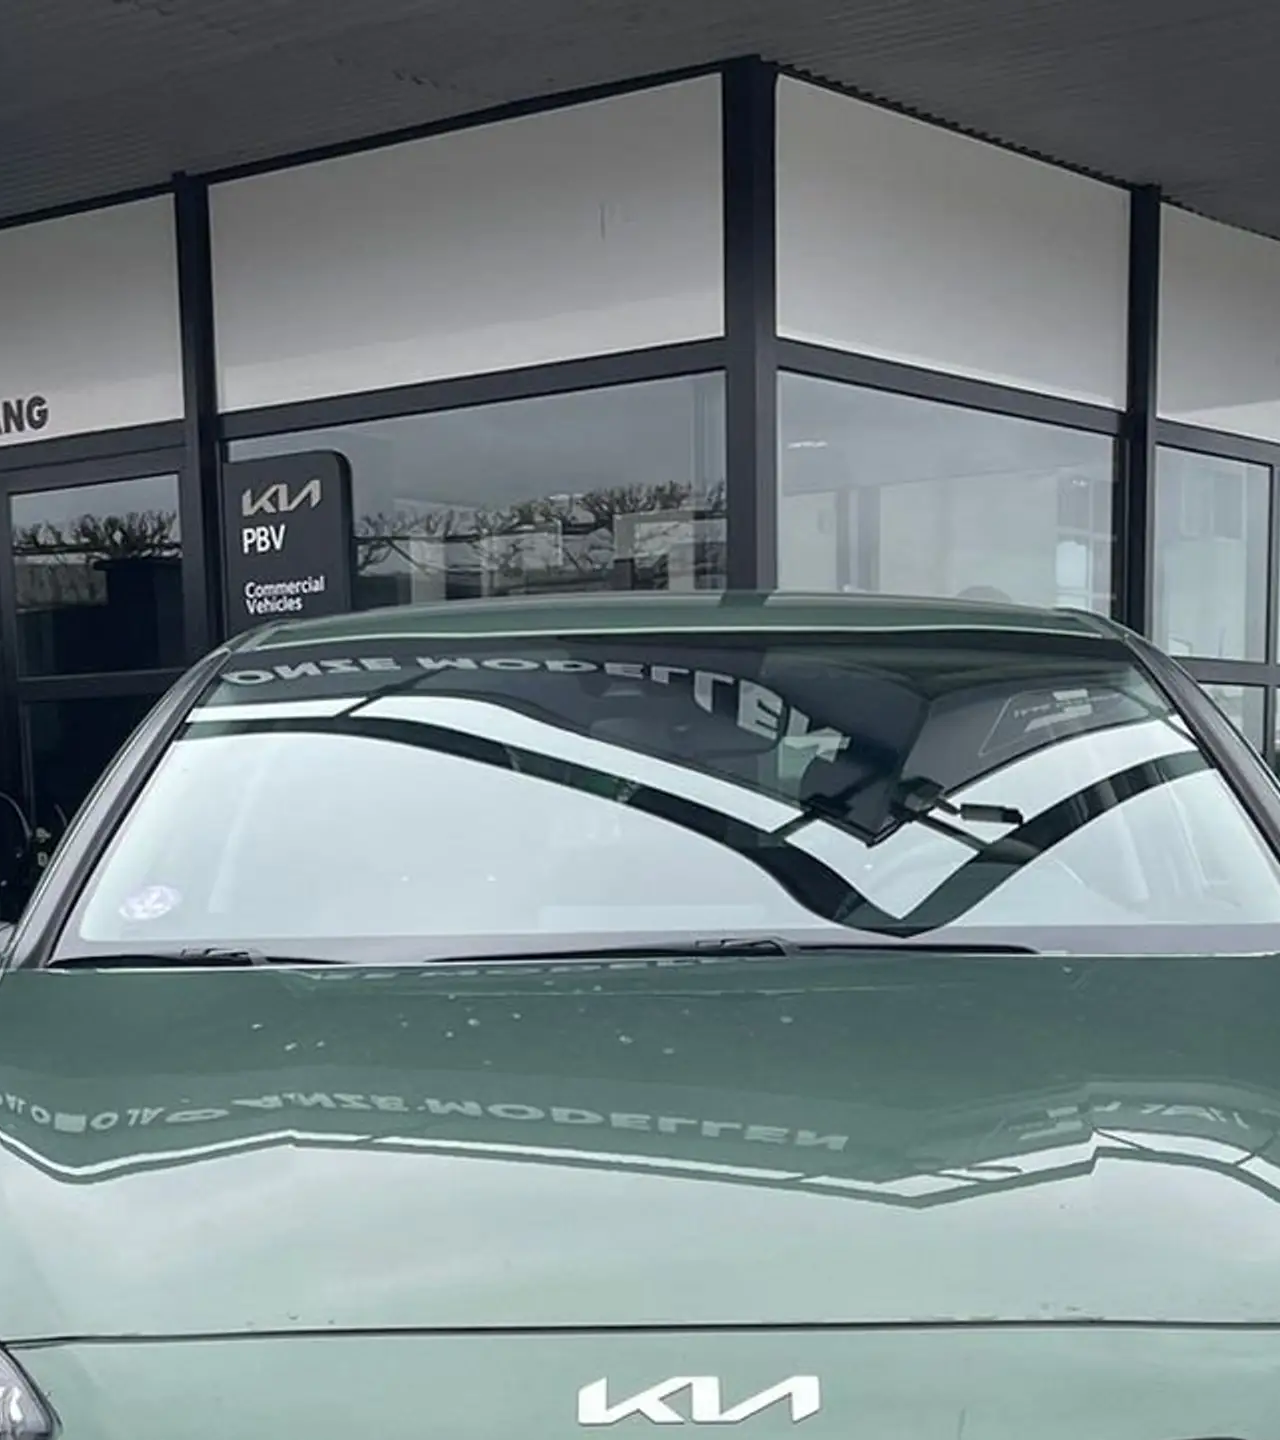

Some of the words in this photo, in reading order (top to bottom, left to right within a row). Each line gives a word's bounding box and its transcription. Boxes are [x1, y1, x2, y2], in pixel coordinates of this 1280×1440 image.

[242, 479, 321, 517] KIA
[242, 523, 286, 554] PBV
[244, 575, 326, 599] Commercial
[246, 595, 304, 615] Vehicles
[578, 1375, 821, 1426] KIA
